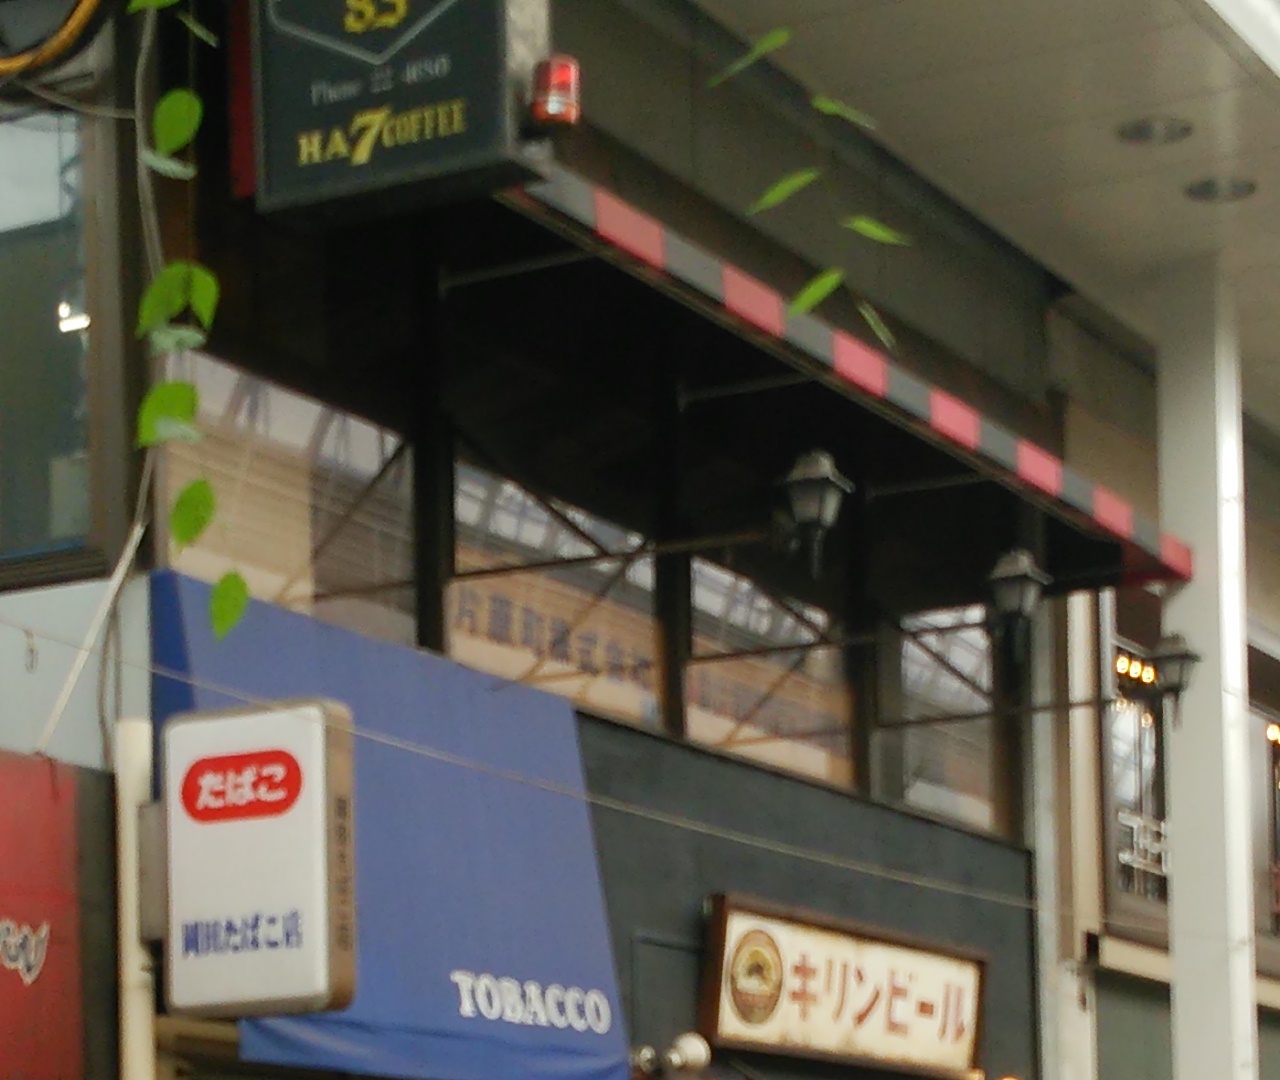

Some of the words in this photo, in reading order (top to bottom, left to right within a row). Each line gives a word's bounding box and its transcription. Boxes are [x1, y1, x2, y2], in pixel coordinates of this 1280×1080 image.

[195, 762, 289, 812] たばこ
[450, 969, 612, 1035] TOBACCO
[790, 952, 967, 1042] キリンビール
